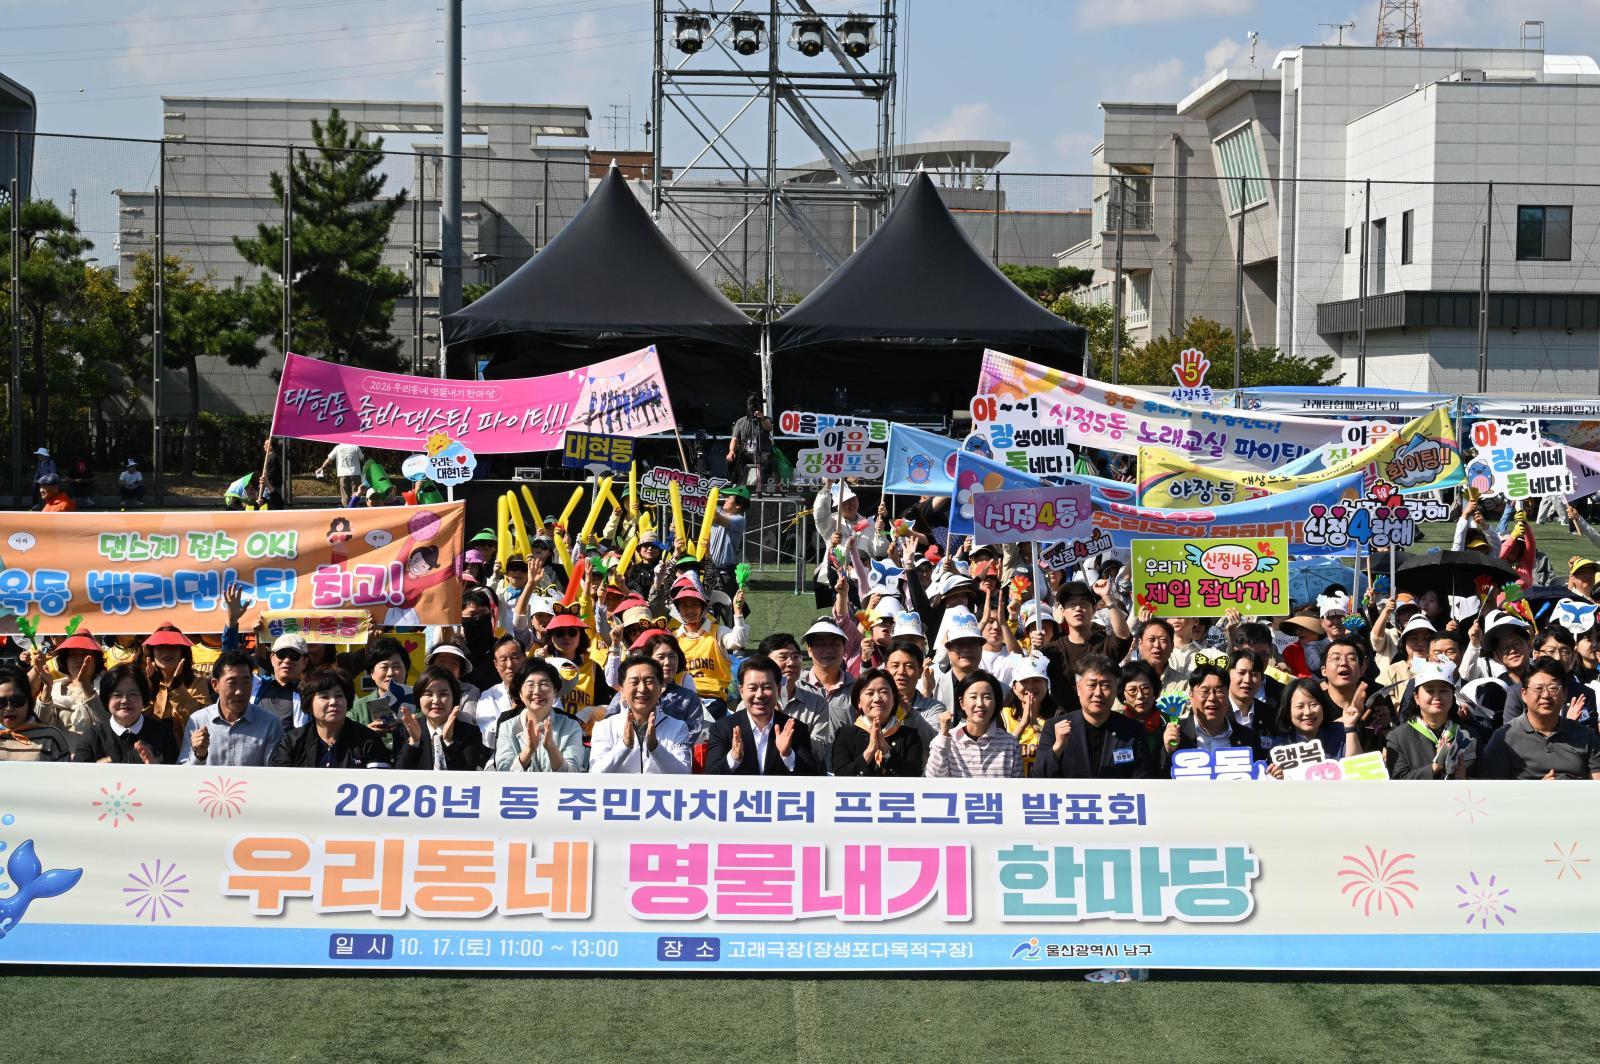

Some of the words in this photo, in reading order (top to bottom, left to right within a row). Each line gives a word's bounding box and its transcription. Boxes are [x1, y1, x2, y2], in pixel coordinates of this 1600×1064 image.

[1185, 362, 1198, 383] 5
[1172, 388, 1212, 401] 신정5동
[283, 388, 350, 427] 대현동
[357, 394, 472, 437] 줌바댄스팀
[824, 431, 865, 452] 야음
[1050, 403, 1129, 441] 신정5동
[1136, 421, 1228, 459] 노래교실
[430, 457, 453, 467] 우리는
[565, 435, 634, 464] 대현동
[436, 467, 471, 480] 대현1촌
[803, 453, 880, 474] 장생포동
[1386, 447, 1451, 481] 화이팅!!
[1170, 480, 1238, 504] 야장동
[985, 498, 1079, 532] 신정4동
[99, 534, 178, 560] 댄스계
[187, 533, 236, 559] 점수
[247, 532, 297, 558] OK!
[1145, 559, 1188, 577] 우리가
[1203, 551, 1254, 571] 신정4동
[0, 568, 72, 615] 옥동
[312, 563, 405, 608] 최고!
[1146, 580, 1191, 607] 제일
[1198, 578, 1280, 607] 잘나가!
[1274, 743, 1322, 769] 행복
[336, 784, 480, 818] 2026년
[501, 787, 538, 819] 동
[560, 789, 814, 823] 주민자치센터
[835, 792, 1002, 824] 프로그램
[1023, 794, 1146, 824] 발표회
[227, 837, 590, 913] 우리동네
[628, 843, 968, 916] 명물내기
[998, 845, 1254, 917] 한마당
[400, 938, 423, 955] 10.
[500, 939, 543, 957] 11:00
[571, 939, 619, 957] 13:00
[728, 941, 973, 959] 고래극장(장생포다목적구장)
[1046, 944, 1117, 958] 울산광역시
[1123, 944, 1152, 958] 남구
